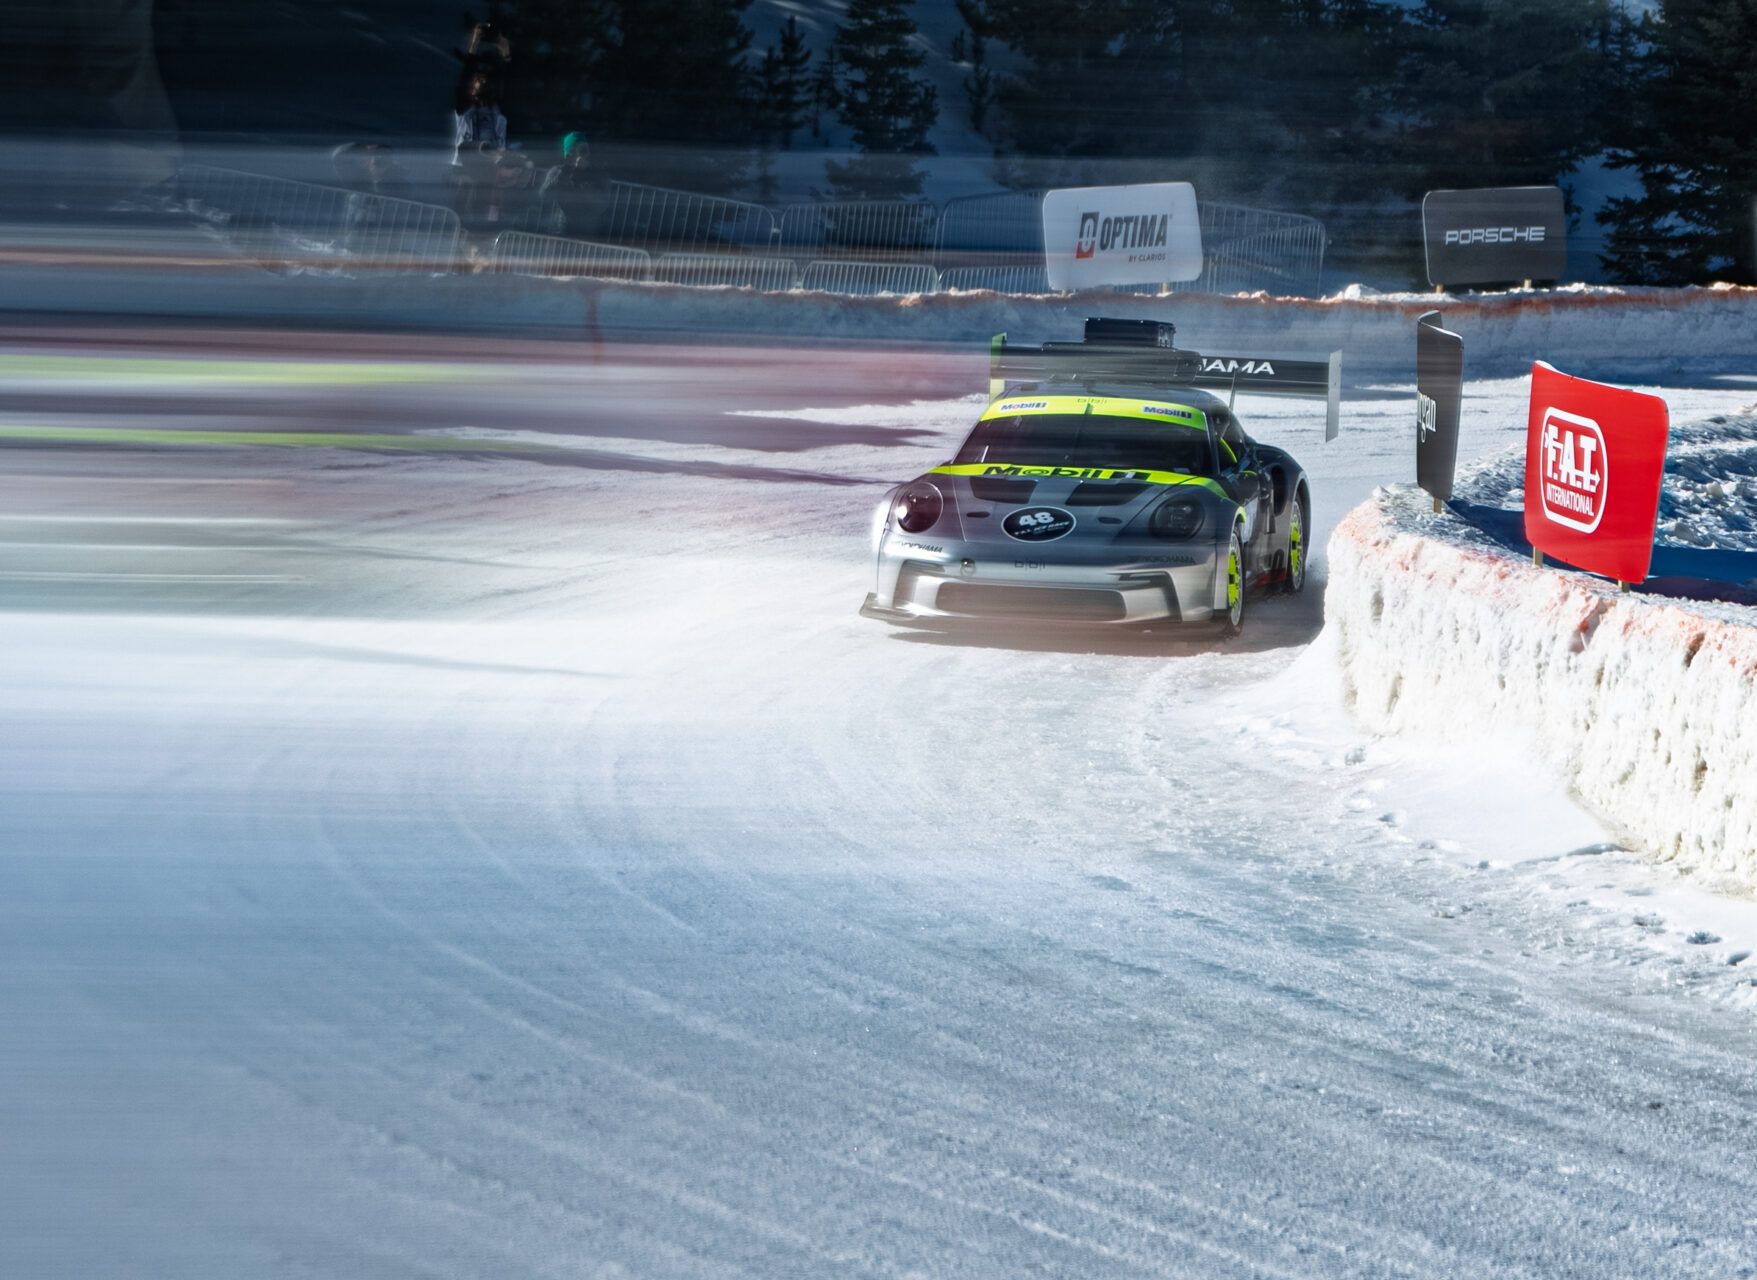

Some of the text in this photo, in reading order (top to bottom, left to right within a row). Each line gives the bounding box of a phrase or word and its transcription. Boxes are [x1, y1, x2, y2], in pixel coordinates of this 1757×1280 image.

[1099, 214, 1168, 251] OPTIMA
[1445, 226, 1546, 245] PORSCHE
[1128, 253, 1166, 263] BY CLARIOS
[1144, 406, 1180, 416] Mobil
[984, 466, 1102, 479] Mobil
[1546, 482, 1595, 517] INTERNATIONAL
[1019, 511, 1055, 526] 48
